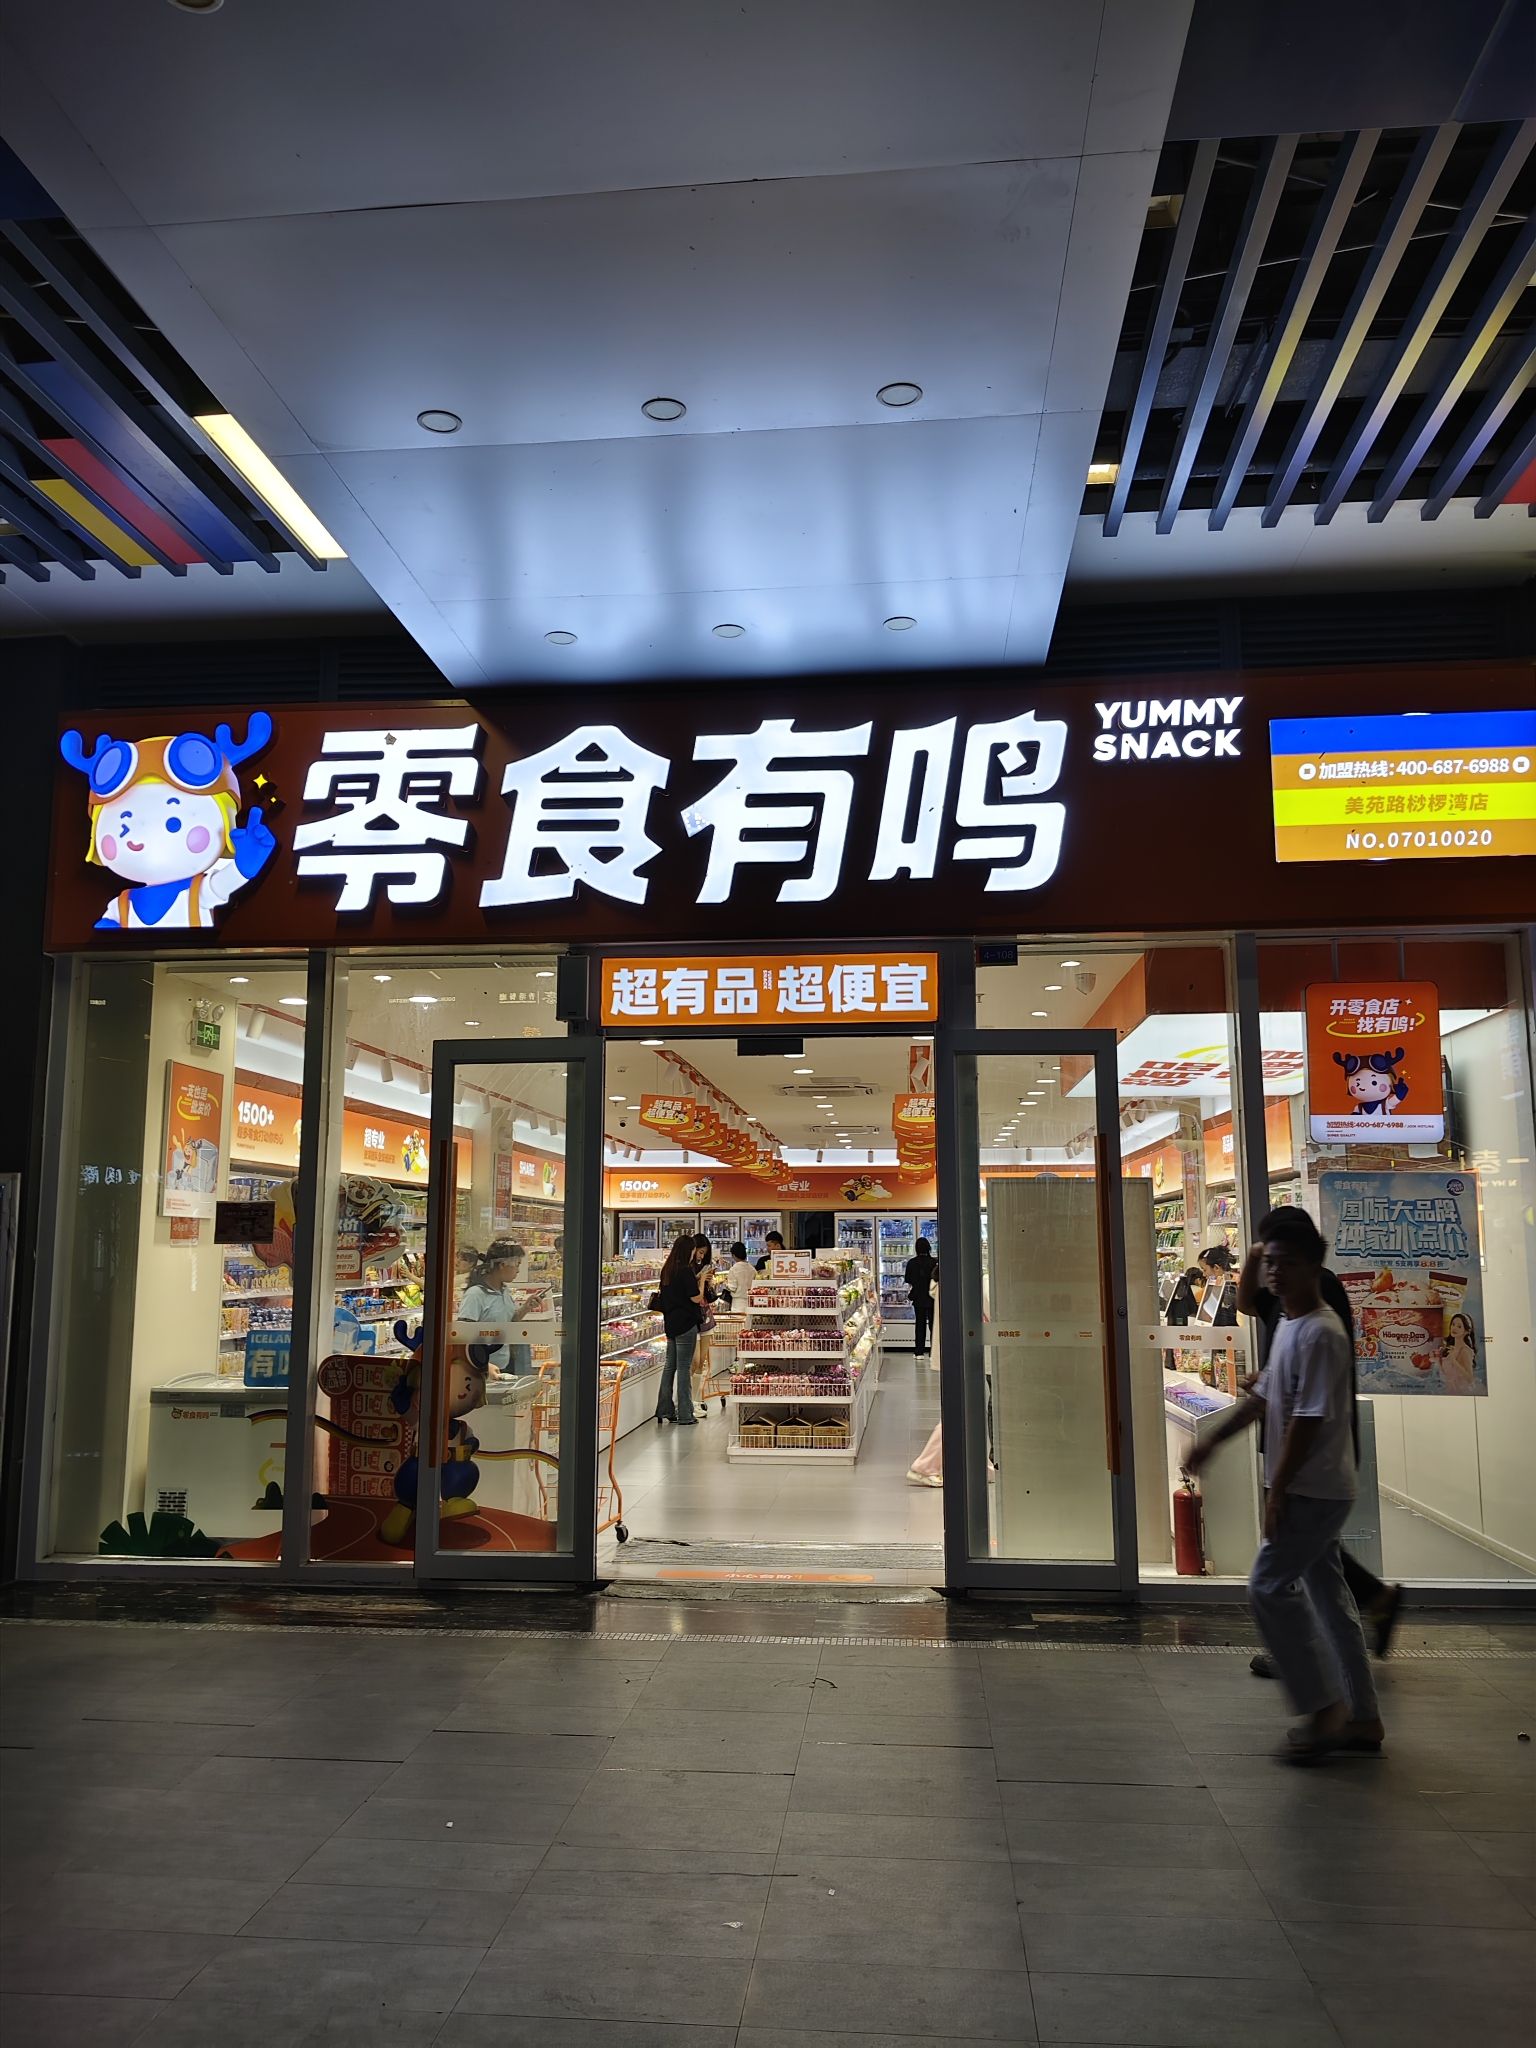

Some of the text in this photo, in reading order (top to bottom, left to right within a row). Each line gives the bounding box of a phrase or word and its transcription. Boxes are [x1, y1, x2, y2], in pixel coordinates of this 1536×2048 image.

[1095, 696, 1244, 729] YUMMY
[1093, 728, 1242, 761] SNACK
[293, 709, 1068, 912] 零食有鸣
[1345, 792, 1489, 815] 美苑路桫椤湾店
[1345, 829, 1492, 849] NO.07010020
[610, 963, 929, 1016] 超有品 超便宜
[1329, 998, 1400, 1016] 开零食店
[237, 1100, 275, 1127] 1500+
[363, 1127, 385, 1150] 超专业
[619, 1180, 659, 1191] 1500+
[1341, 1197, 1459, 1224] 国际大品牌
[1337, 1221, 1466, 1256] 独家冰点价
